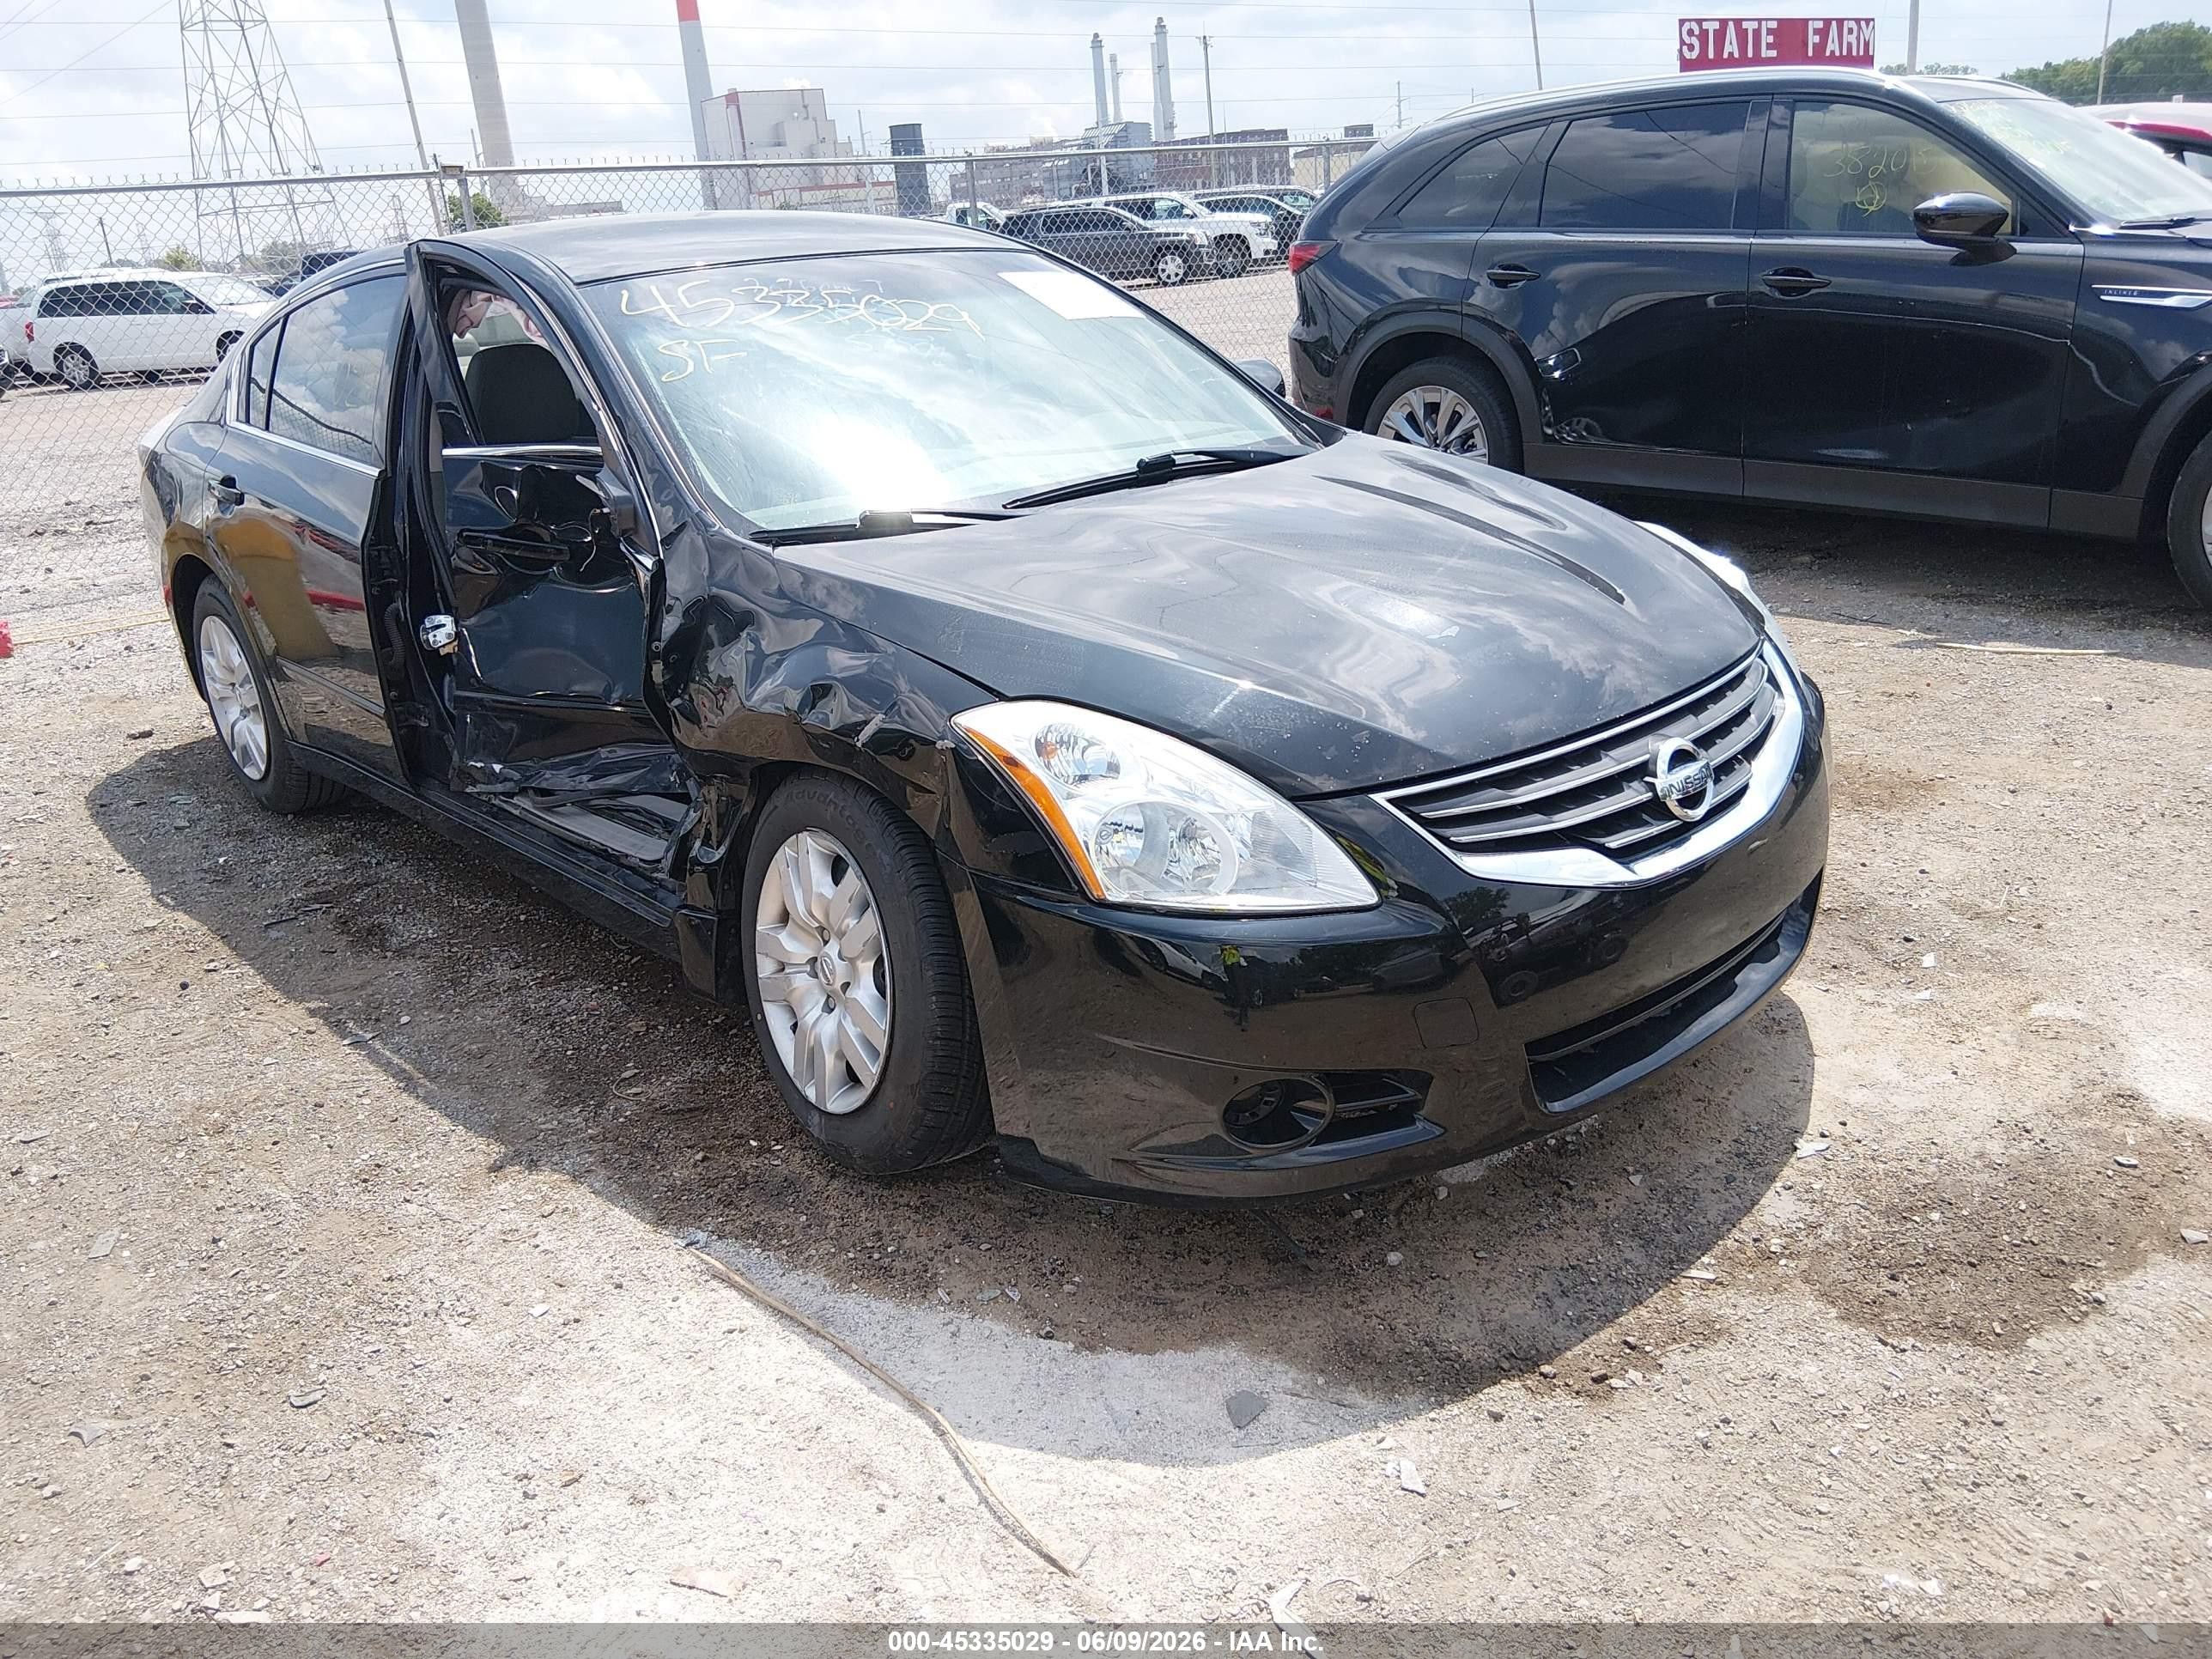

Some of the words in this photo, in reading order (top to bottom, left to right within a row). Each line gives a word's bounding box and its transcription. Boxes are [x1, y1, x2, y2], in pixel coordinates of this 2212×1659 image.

[1681, 20, 1778, 60] STATE
[1808, 20, 1875, 57] FARM
[620, 279, 987, 343] 45335029
[1668, 761, 1714, 796] NISSAN
